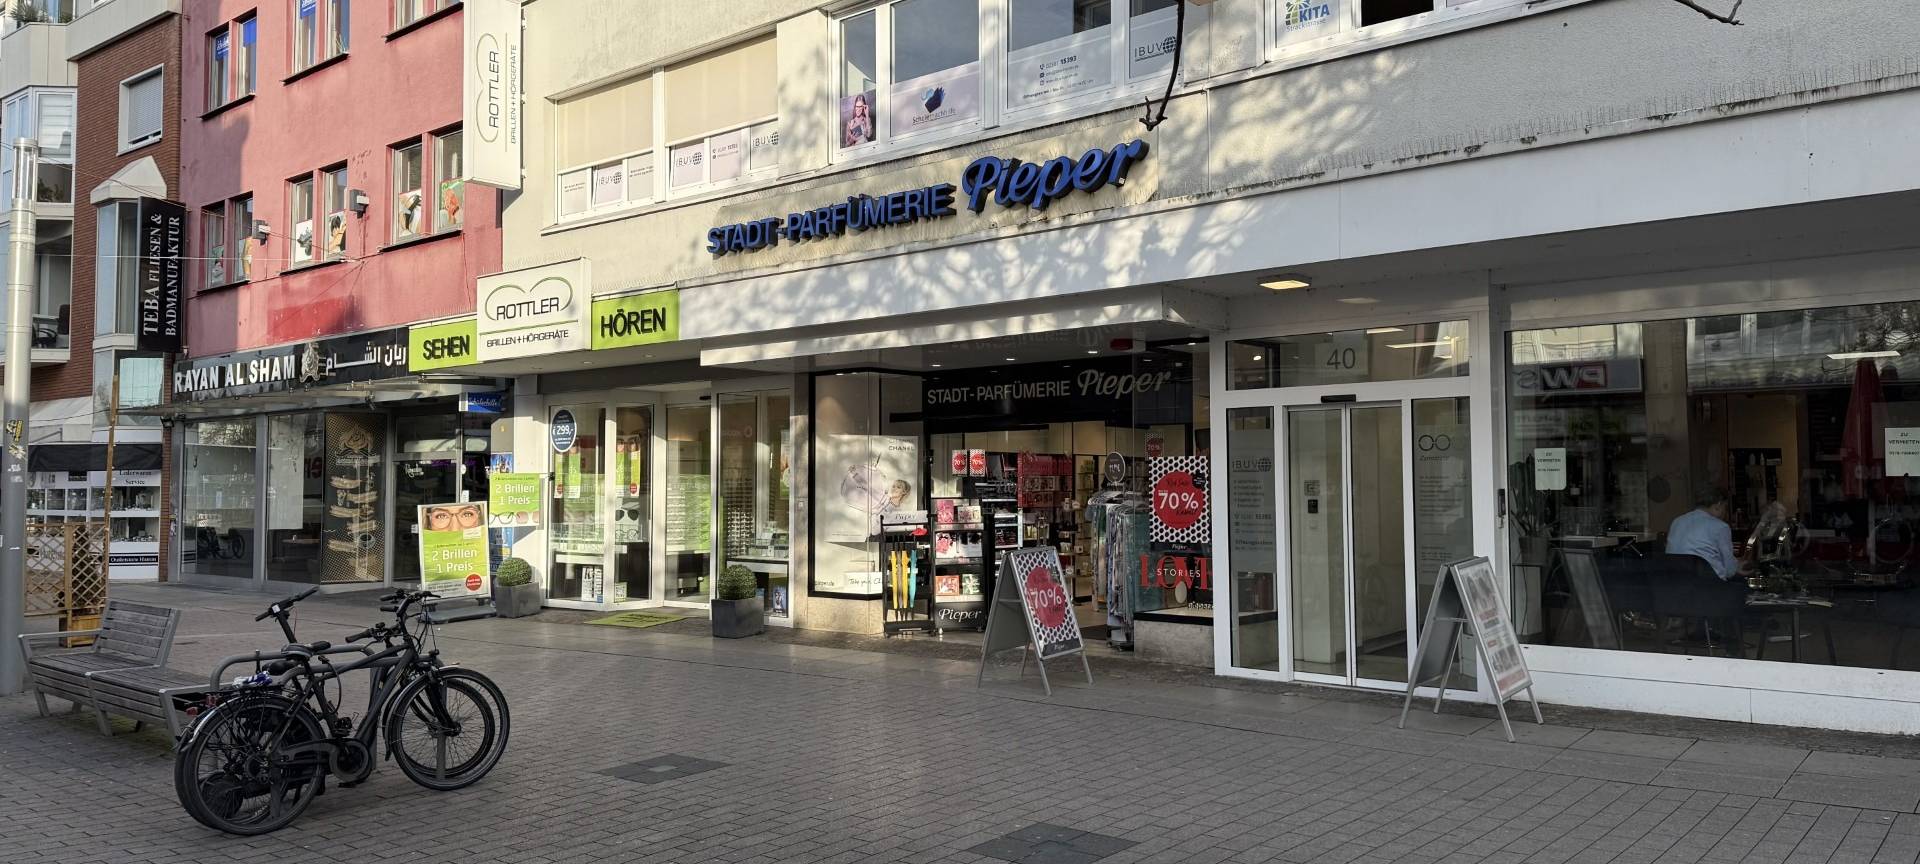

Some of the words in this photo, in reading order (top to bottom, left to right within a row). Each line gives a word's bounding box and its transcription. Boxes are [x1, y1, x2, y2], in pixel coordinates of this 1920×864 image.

[1299, 4, 1330, 22] KITA
[1134, 43, 1163, 57] IBUV
[489, 51, 500, 128] ROTTLER
[707, 181, 957, 256] STADT-PARFÜMERIE
[962, 138, 1150, 214] Pieper
[151, 213, 162, 225] &
[149, 226, 161, 281] FLIESEN
[165, 217, 180, 336] BADMANUFAKTUR
[143, 288, 160, 335] TEBA
[496, 297, 560, 321] ROTTLER
[600, 307, 667, 338] HÖREN
[423, 334, 471, 360] SEHEN
[1326, 347, 1356, 370] 40
[174, 365, 220, 394] RAYAN
[224, 362, 244, 387] AL
[249, 354, 296, 384] SHAM
[927, 380, 1071, 405] STADT-PARFÜMERIE
[1077, 369, 1172, 399] Pieper
[495, 484, 501, 494] 2
[504, 483, 535, 493] Brillen
[508, 496, 530, 505] Preis
[1157, 492, 1199, 510] 70%
[432, 550, 439, 561] 2
[442, 549, 477, 560] Brillen
[446, 561, 473, 573] Preis
[1157, 569, 1201, 578] STORIES
[1030, 587, 1062, 609] 70%
[938, 608, 982, 622] Pieper
